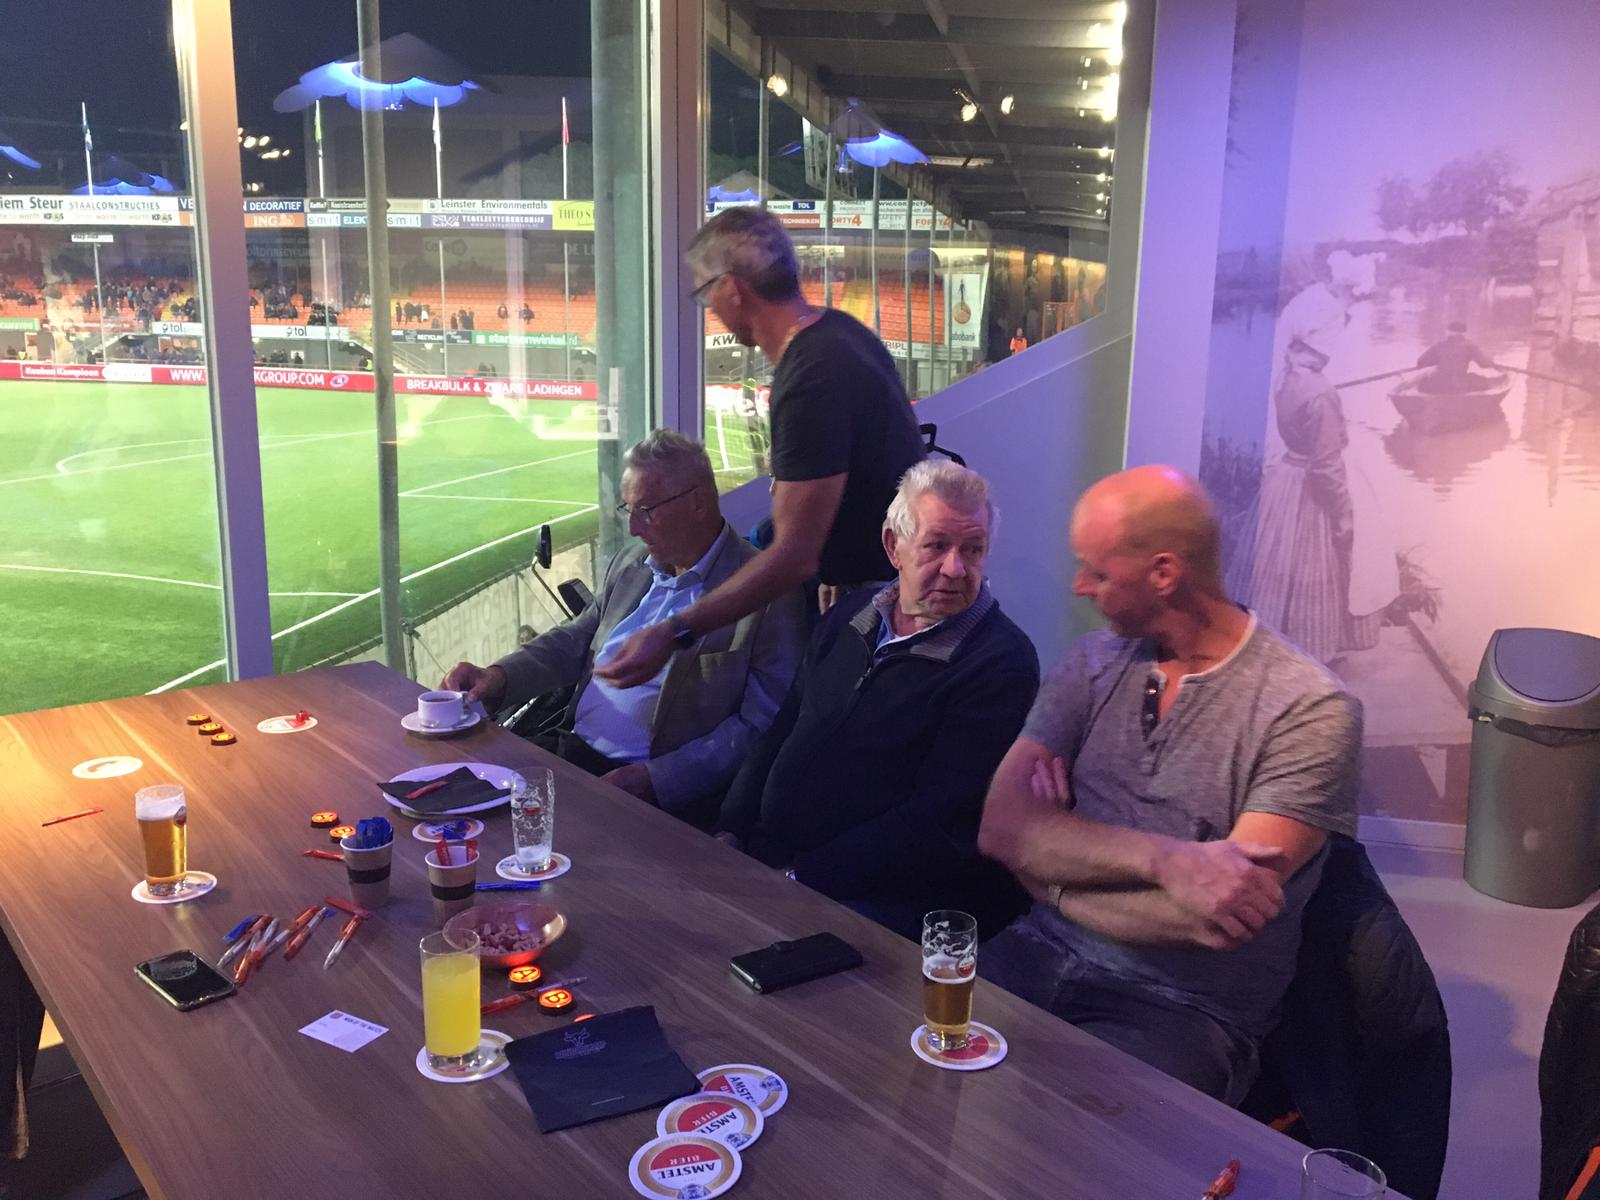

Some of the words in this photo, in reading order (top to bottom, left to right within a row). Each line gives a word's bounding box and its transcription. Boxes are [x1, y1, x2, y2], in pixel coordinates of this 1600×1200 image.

[30, 197, 63, 209] Steur
[69, 202, 160, 210] STAALCONSTRUCTIES
[250, 201, 302, 211] DECORATIEF
[441, 200, 476, 209] Leinster
[481, 200, 548, 210] Environmentals
[253, 215, 279, 226] ING
[308, 215, 341, 225] smit
[386, 215, 420, 225] smit
[170, 323, 183, 333] tol
[294, 326, 308, 337] tol
[406, 379, 471, 393] BREAKBULK
[473, 381, 481, 392] &
[527, 383, 582, 396] LADINGEN
[513, 968, 538, 980] A
[545, 991, 569, 1005] B
[692, 1110, 718, 1127] BIER
[669, 1155, 700, 1166] BIER
[657, 1162, 716, 1180] AMSTEL
